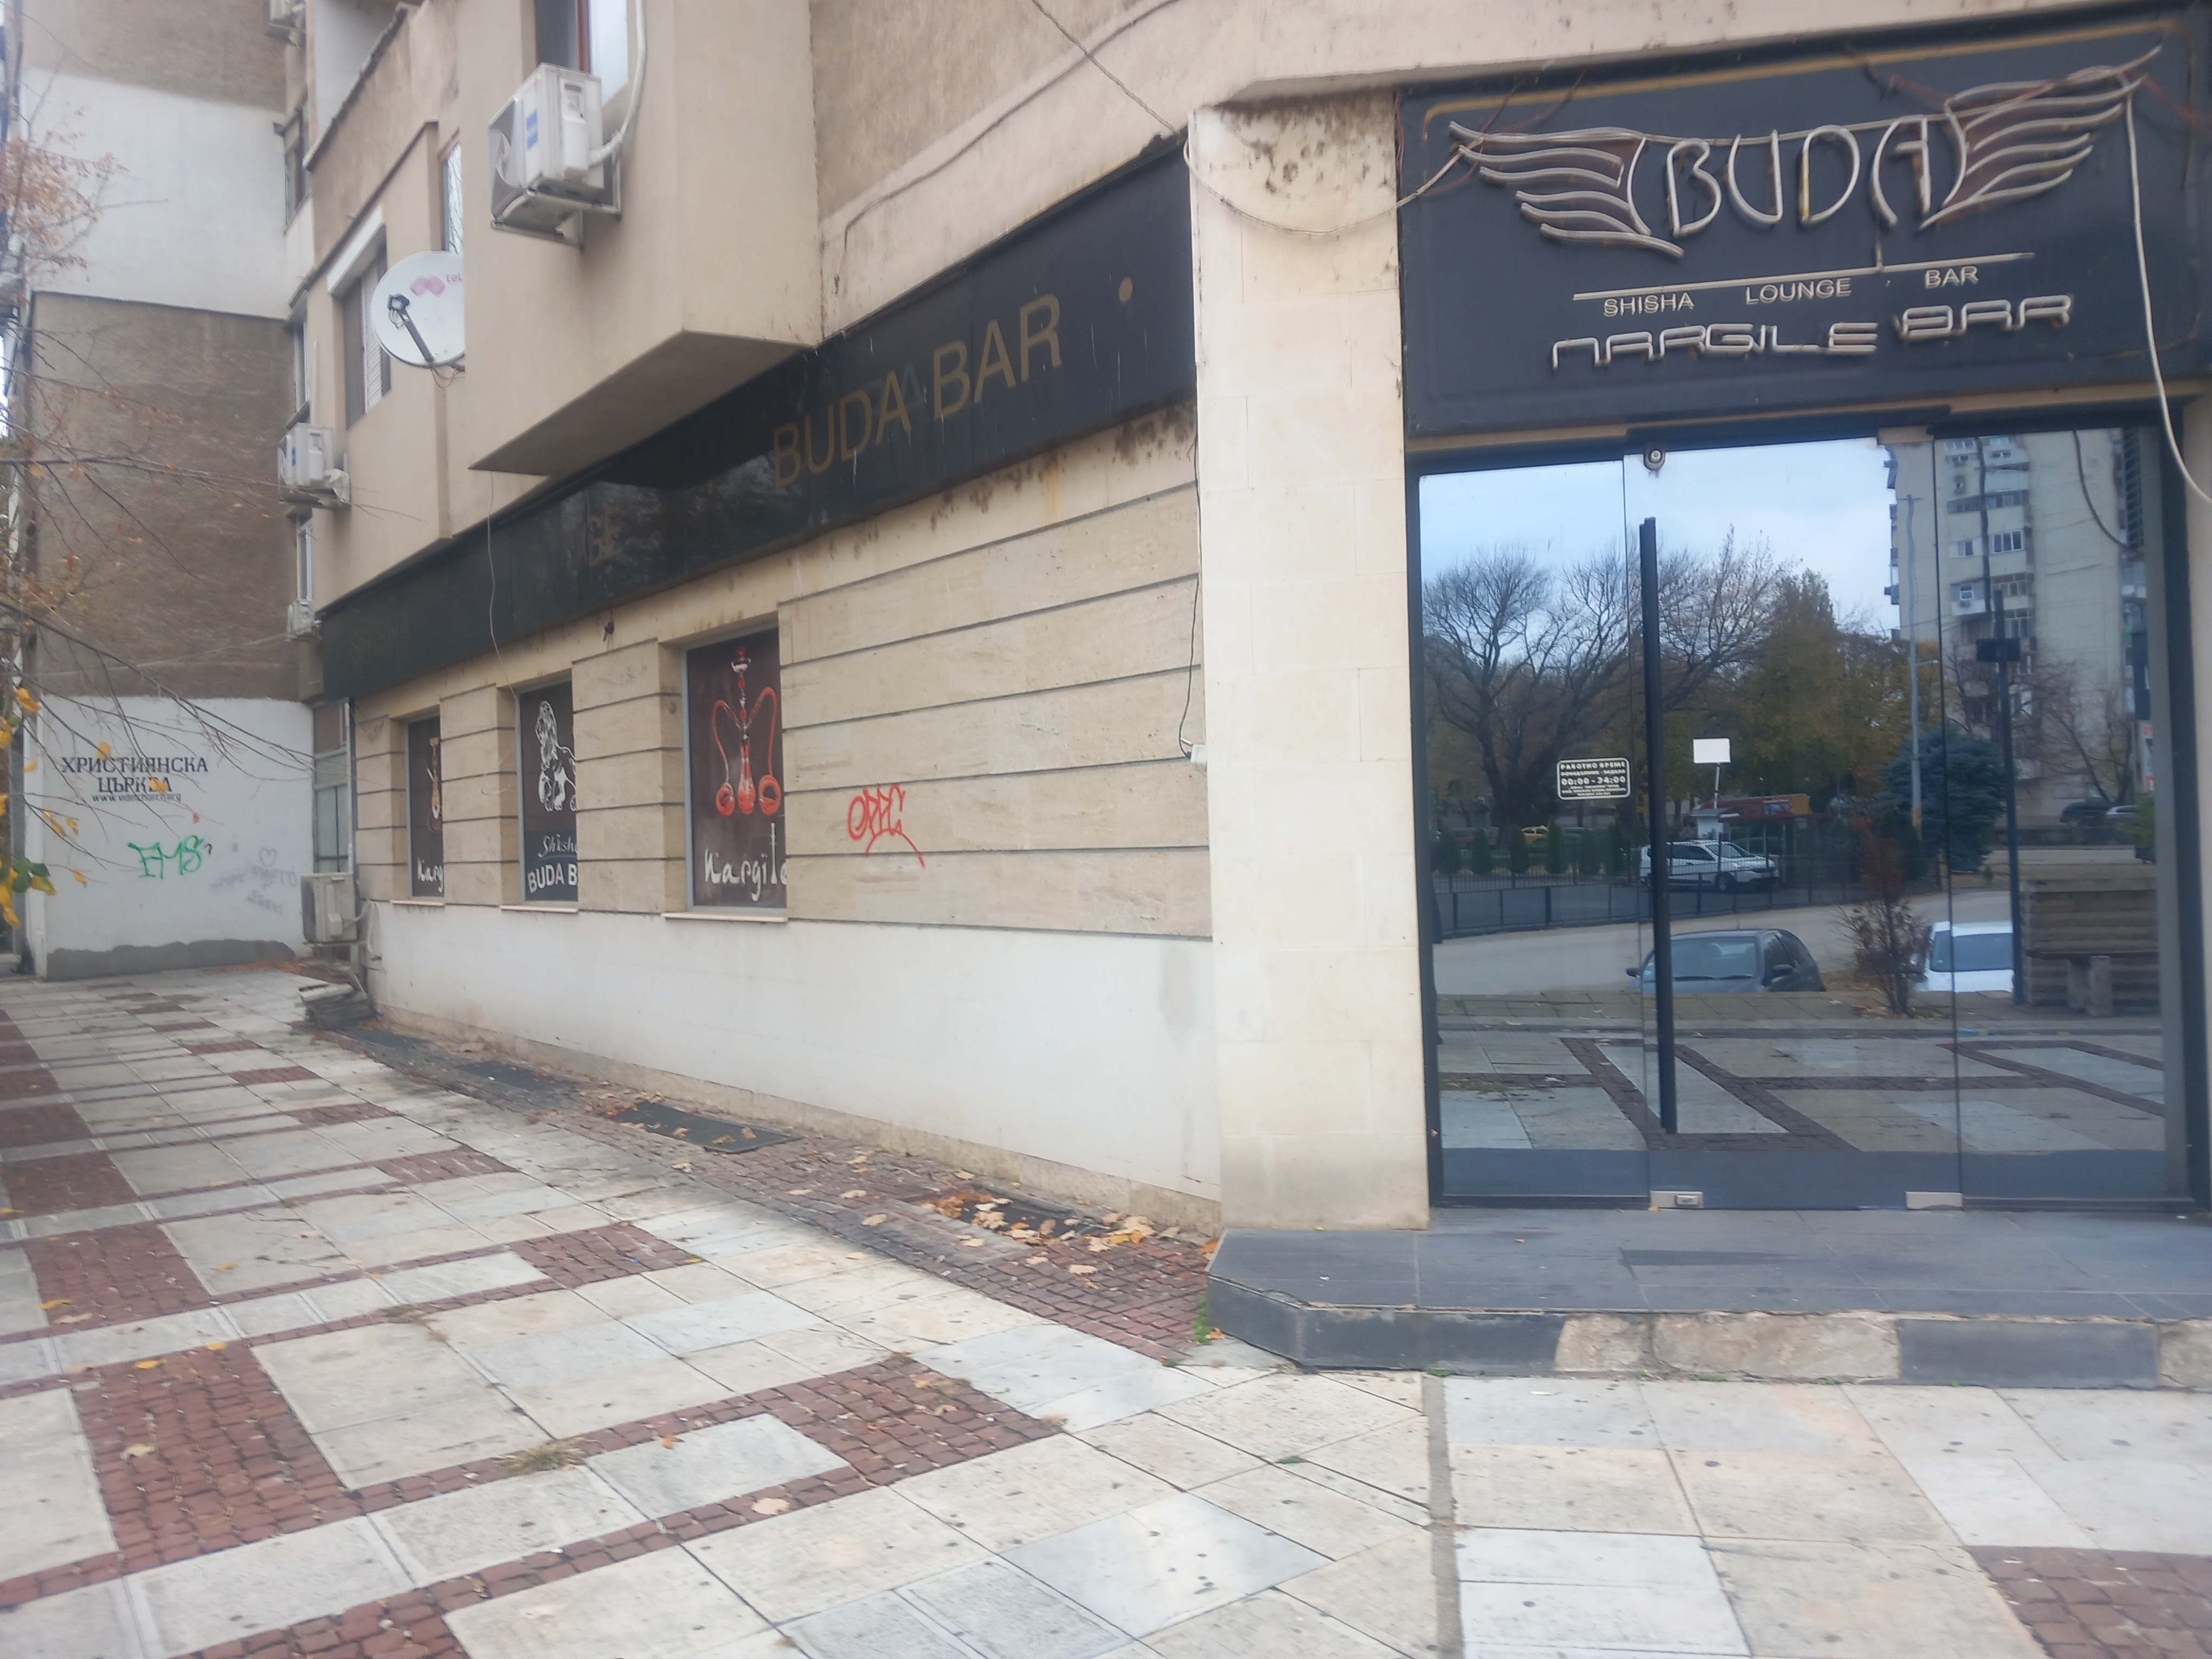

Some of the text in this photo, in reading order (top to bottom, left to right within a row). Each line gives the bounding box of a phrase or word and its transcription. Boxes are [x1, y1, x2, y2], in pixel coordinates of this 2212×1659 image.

[1667, 114, 1931, 236] BUDA
[1603, 265, 1979, 317] SHISHA LOUNGE BAR
[1552, 294, 2072, 371] NARGILE BAR
[773, 293, 1062, 488] BUDA BAR
[538, 834, 578, 857] Shish
[527, 863, 564, 893] BUDA
